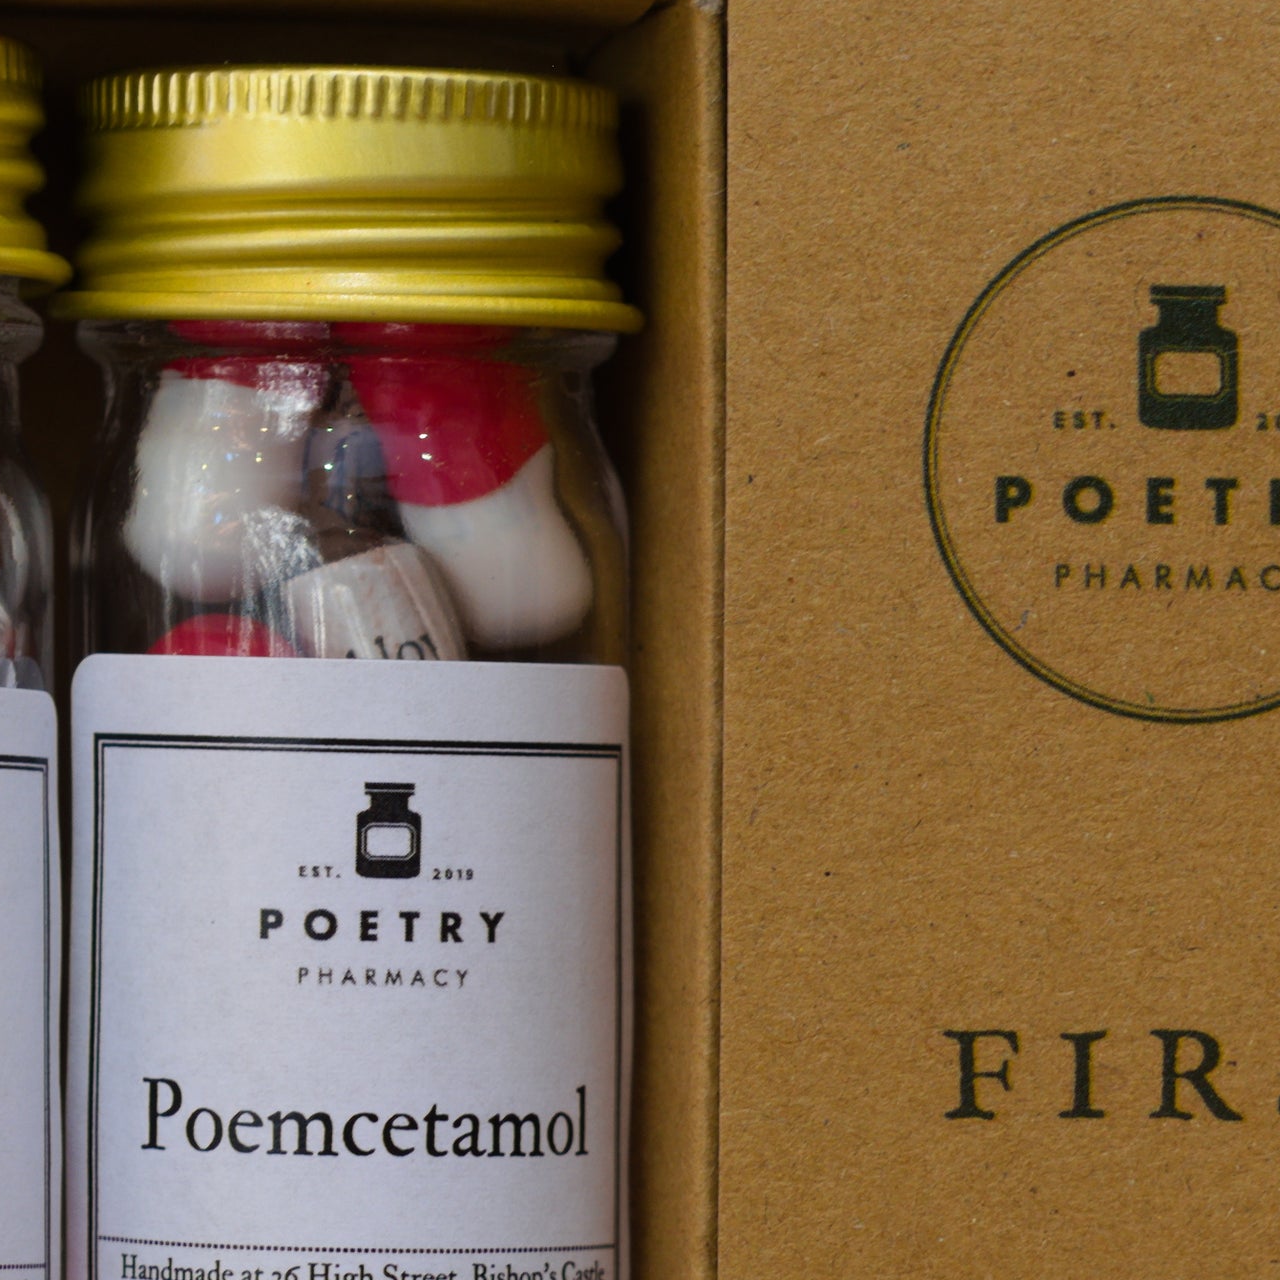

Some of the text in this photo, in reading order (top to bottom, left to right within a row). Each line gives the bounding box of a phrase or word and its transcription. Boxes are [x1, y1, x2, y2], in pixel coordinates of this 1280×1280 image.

[1052, 409, 1117, 431] EST.
[298, 864, 475, 882] EST. 2019
[259, 907, 506, 944] POETRY
[297, 966, 470, 989] PHARMACY
[140, 1076, 590, 1159] Poemcetamol
